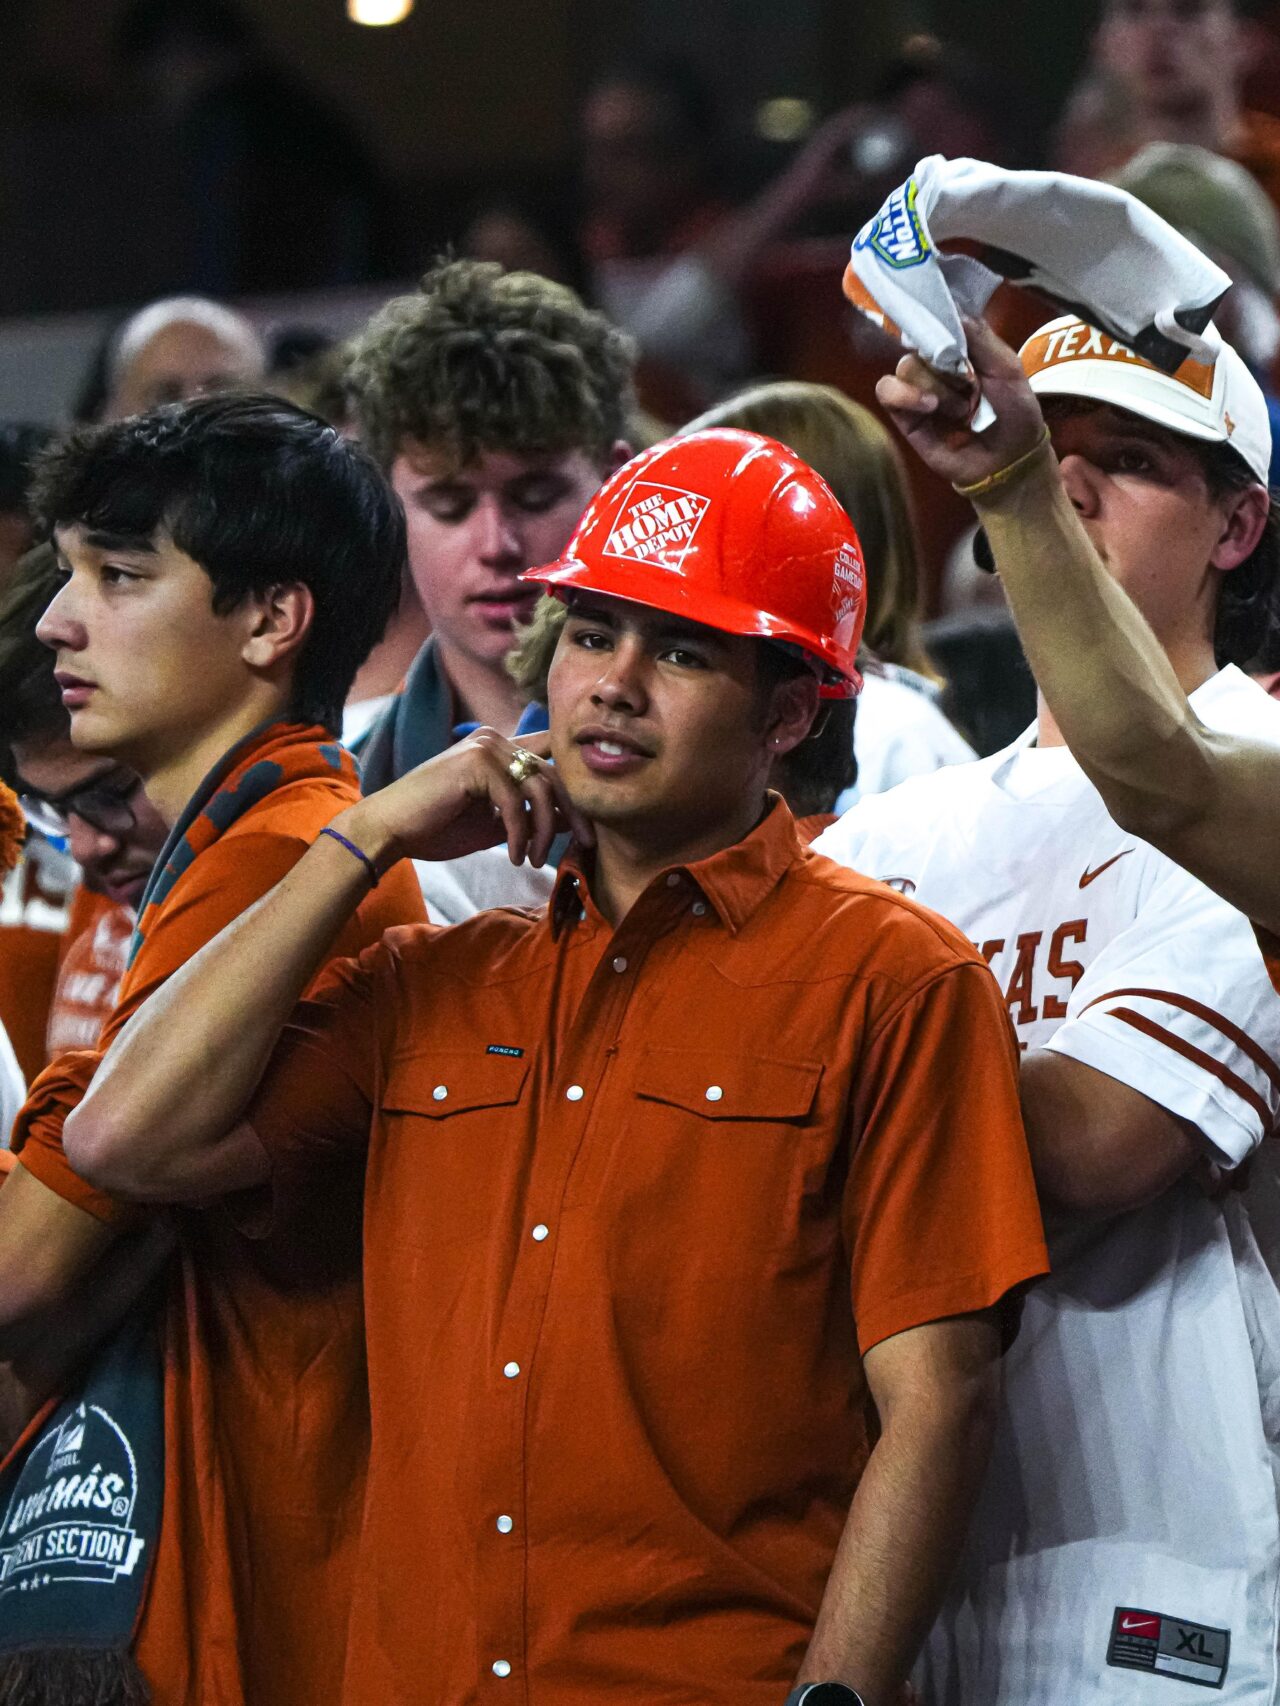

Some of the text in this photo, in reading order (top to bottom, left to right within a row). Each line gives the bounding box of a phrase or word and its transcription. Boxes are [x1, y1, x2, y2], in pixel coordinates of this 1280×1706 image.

[1043, 324, 1138, 363] TEXA
[628, 493, 665, 518] THE
[610, 494, 703, 556] HOME
[633, 521, 692, 560] DEPOT
[45, 1528, 125, 1561] SECTION
[1175, 1627, 1214, 1659] XL
